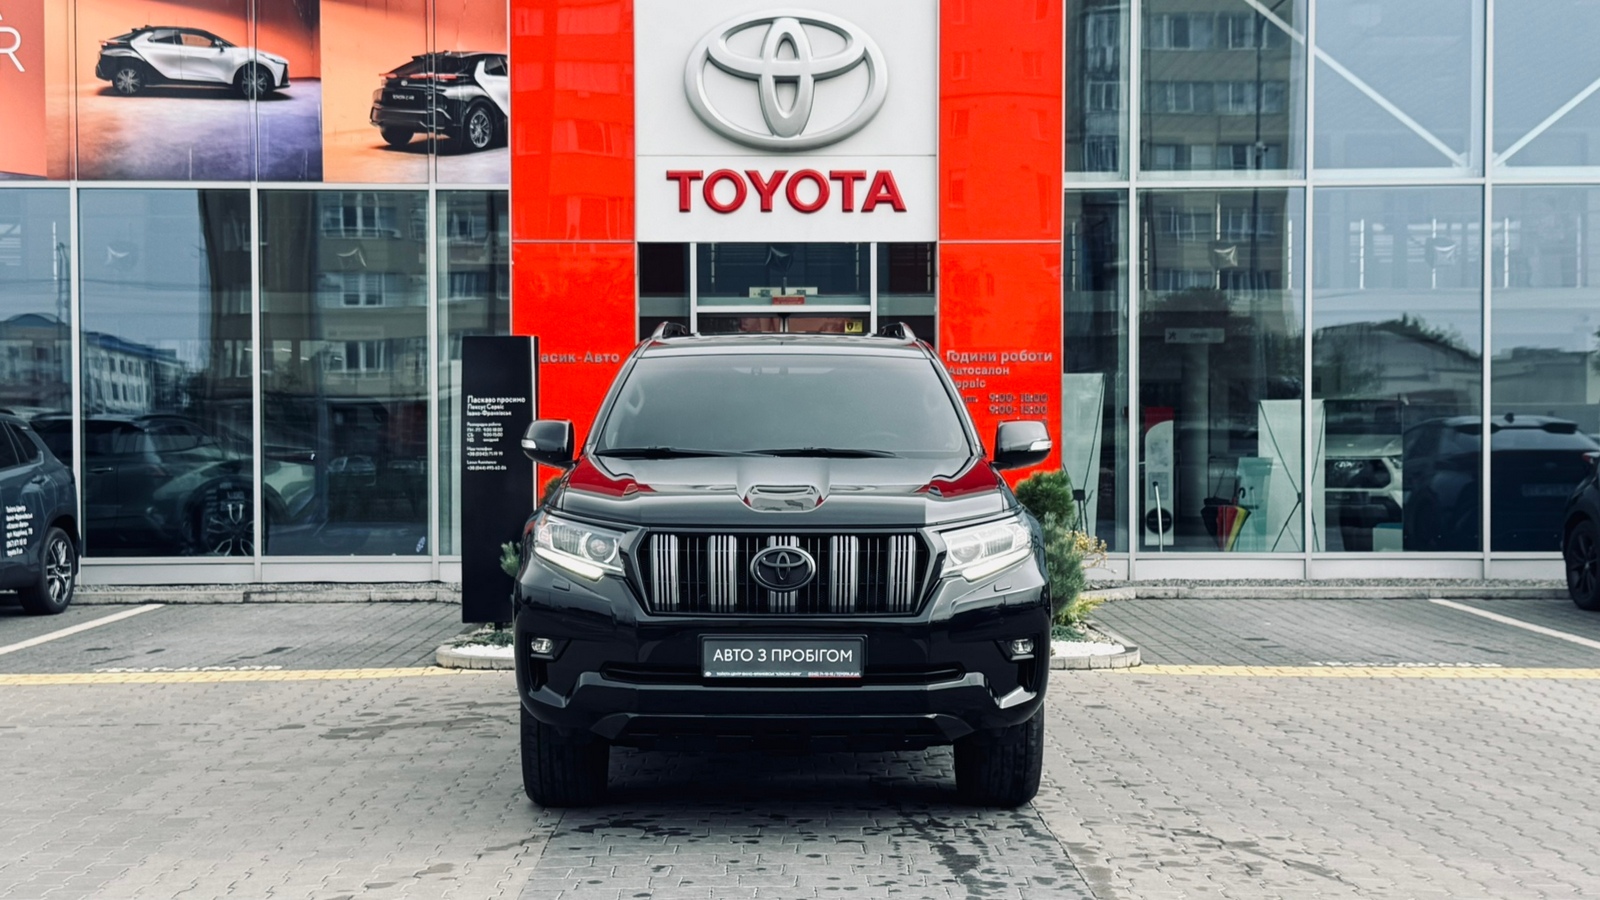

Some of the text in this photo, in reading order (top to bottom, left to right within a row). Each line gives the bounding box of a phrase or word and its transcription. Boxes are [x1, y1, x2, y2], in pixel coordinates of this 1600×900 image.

[666, 169, 907, 214] TOYOTA
[540, 350, 621, 363] асик-Авто
[946, 350, 1053, 365] Години роботи
[948, 366, 1010, 375] Автосалон
[955, 378, 986, 390] ервіс
[713, 648, 754, 662] АВТО
[771, 648, 853, 662] ПРОБІГОМ
